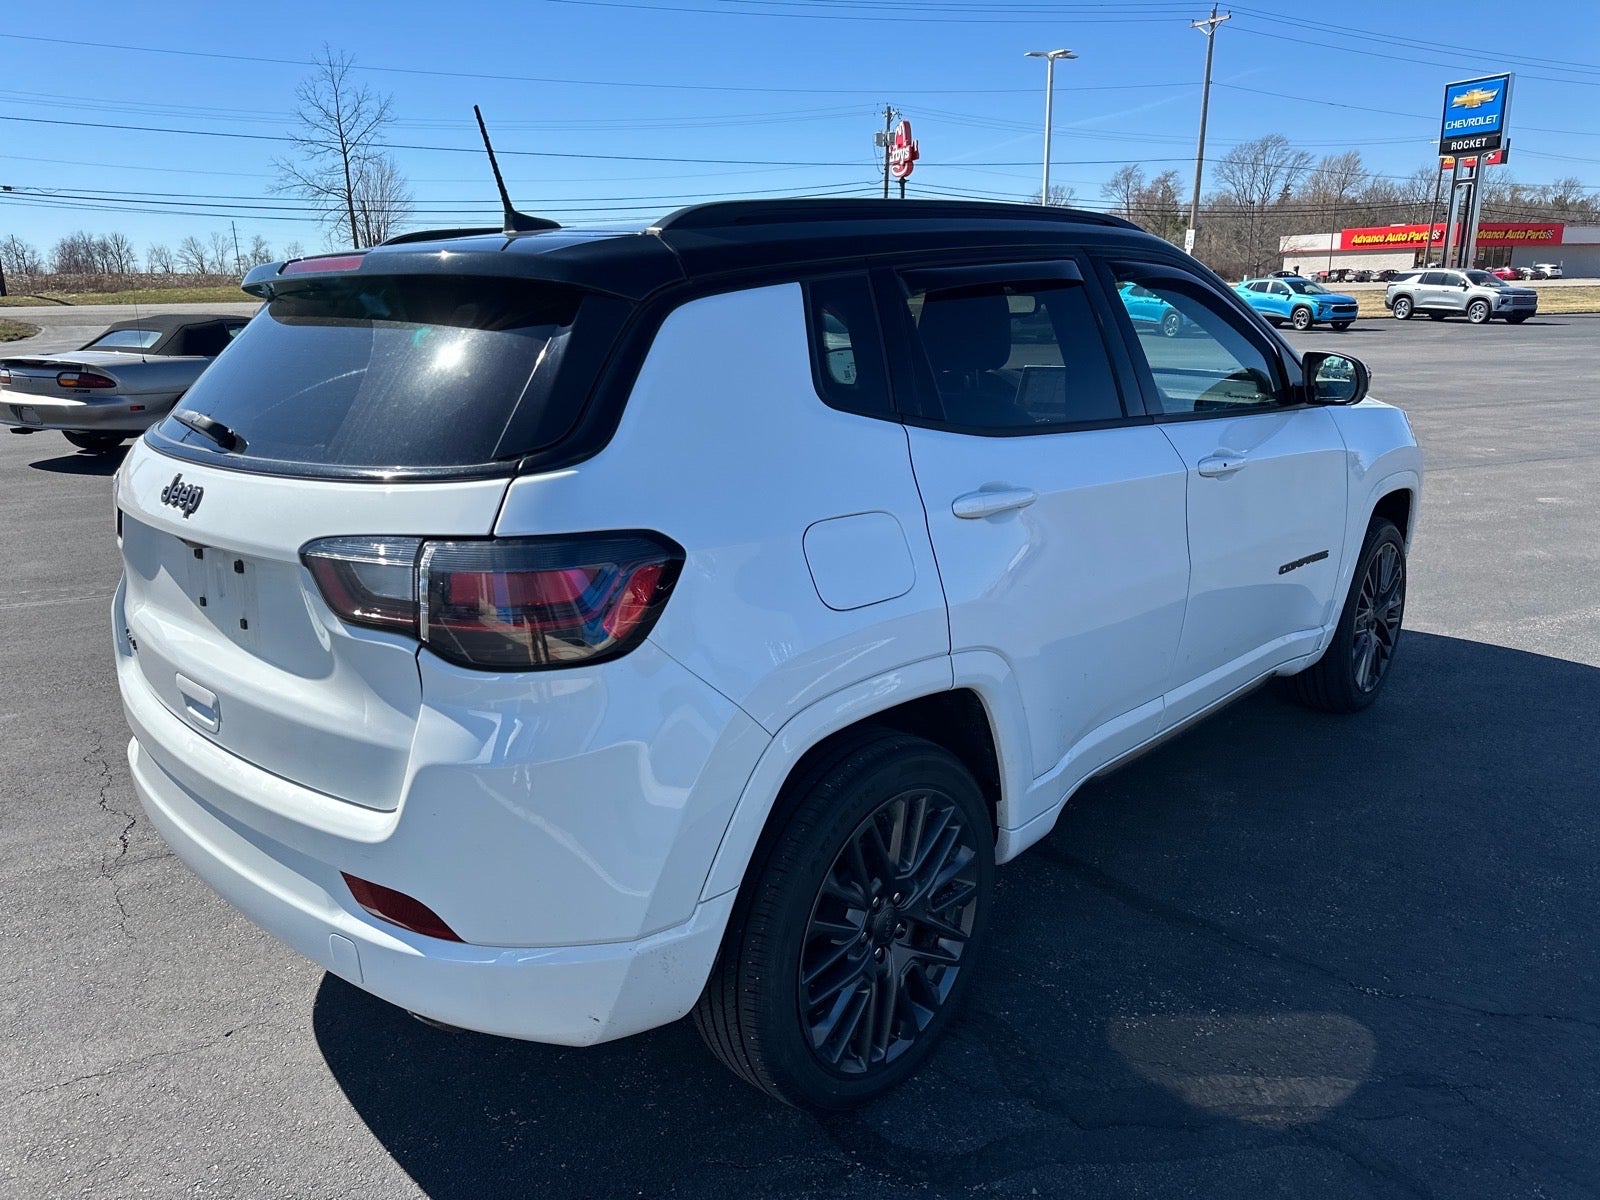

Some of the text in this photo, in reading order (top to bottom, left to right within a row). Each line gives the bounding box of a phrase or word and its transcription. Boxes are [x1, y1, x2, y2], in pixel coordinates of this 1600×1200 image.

[1445, 114, 1498, 130] CHEVROLET
[1450, 138, 1488, 151] ROCKET
[1351, 231, 1431, 244] Advance Auto Part
[1476, 229, 1546, 240] dvance Auto Parts
[161, 473, 204, 519] Jeep
